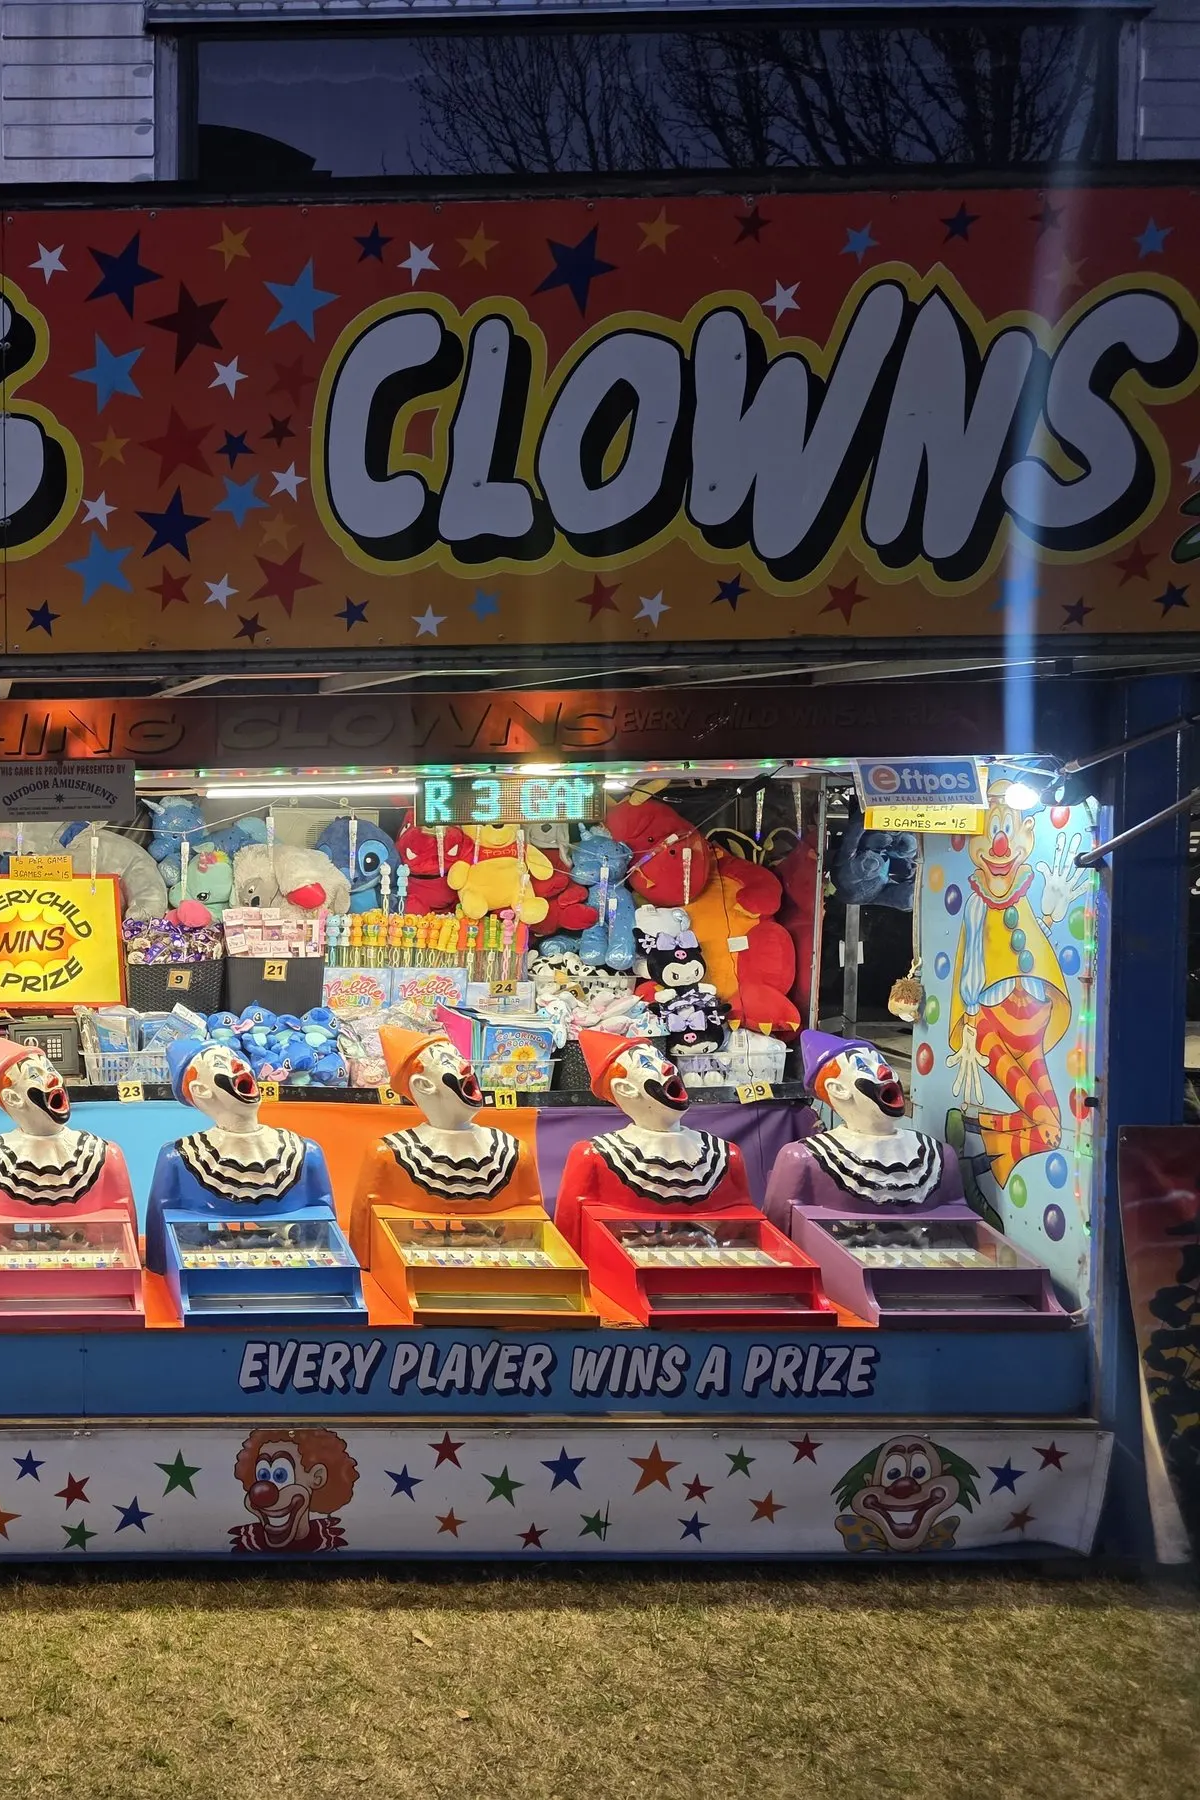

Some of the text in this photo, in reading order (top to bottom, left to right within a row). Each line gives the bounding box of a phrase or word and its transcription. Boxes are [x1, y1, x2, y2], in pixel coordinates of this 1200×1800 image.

[325, 276, 1197, 584] CLOWNS
[217, 701, 618, 751] CLOWNS
[621, 708, 690, 733] EVERY
[788, 703, 856, 730] WINS
[857, 703, 880, 729] A
[15, 766, 33, 776] GAME
[36, 766, 42, 776] IS
[44, 765, 75, 776] PROUDLY
[76, 764, 114, 775] PRESENTED
[117, 764, 125, 773] BY
[868, 765, 970, 793] eftpos
[2, 777, 119, 807] OUTDOOR AMUSEMENTS
[424, 780, 452, 822] R
[471, 780, 501, 822] 3
[883, 818, 890, 828] 3
[894, 819, 931, 828] GAMES
[952, 818, 967, 829] $15
[47, 856, 68, 864] GAME
[36, 891, 93, 939] CHILD
[0, 955, 84, 993] PRIZE
[267, 965, 283, 975] 21
[174, 975, 184, 984] 9
[324, 979, 383, 998] Bubble
[399, 979, 459, 998] Bubble
[495, 983, 512, 994] 24
[496, 1031, 543, 1042] COLORING
[122, 1086, 141, 1098] 23
[385, 1088, 395, 1100] 6
[499, 1094, 514, 1106] 11
[744, 1085, 766, 1099] 29
[237, 1339, 883, 1398] EVERY PLAYER WINS A PRIZE
